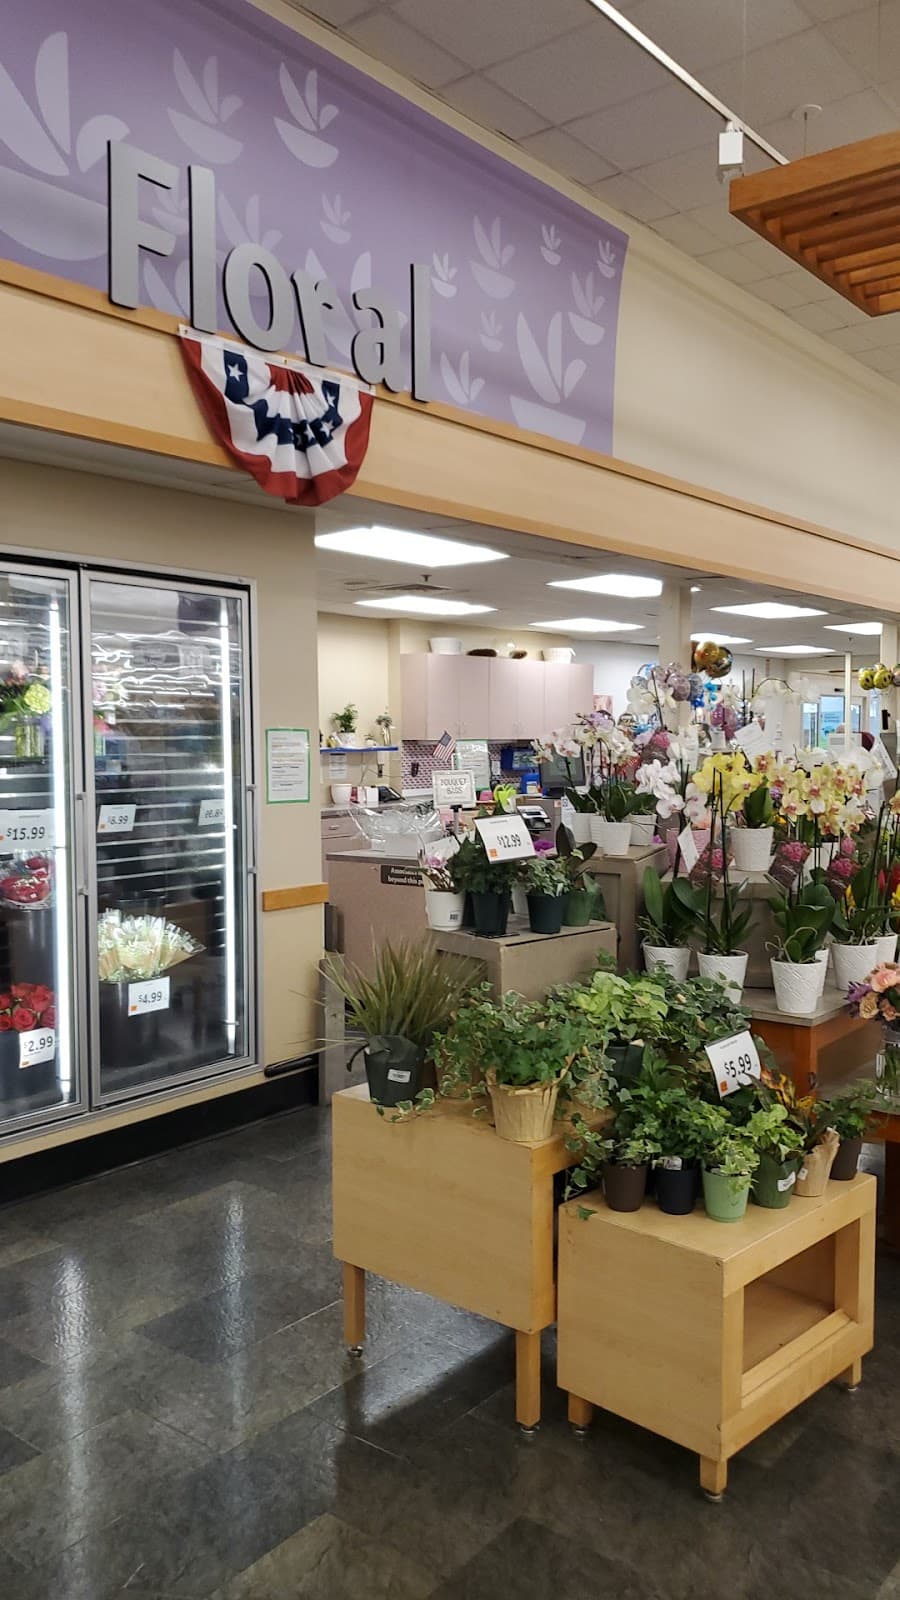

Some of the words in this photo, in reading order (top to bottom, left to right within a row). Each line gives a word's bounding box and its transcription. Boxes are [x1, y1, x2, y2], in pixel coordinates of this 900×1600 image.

[107, 140, 432, 403] Floral
[6, 826, 46, 841] $15.99
[496, 833, 522, 848] $12.99
[387, 875, 407, 885] beyond
[407, 876, 418, 885] this
[138, 991, 162, 1004] $4.99
[23, 1035, 54, 1053] $2.99
[723, 1053, 752, 1078] $5.99
